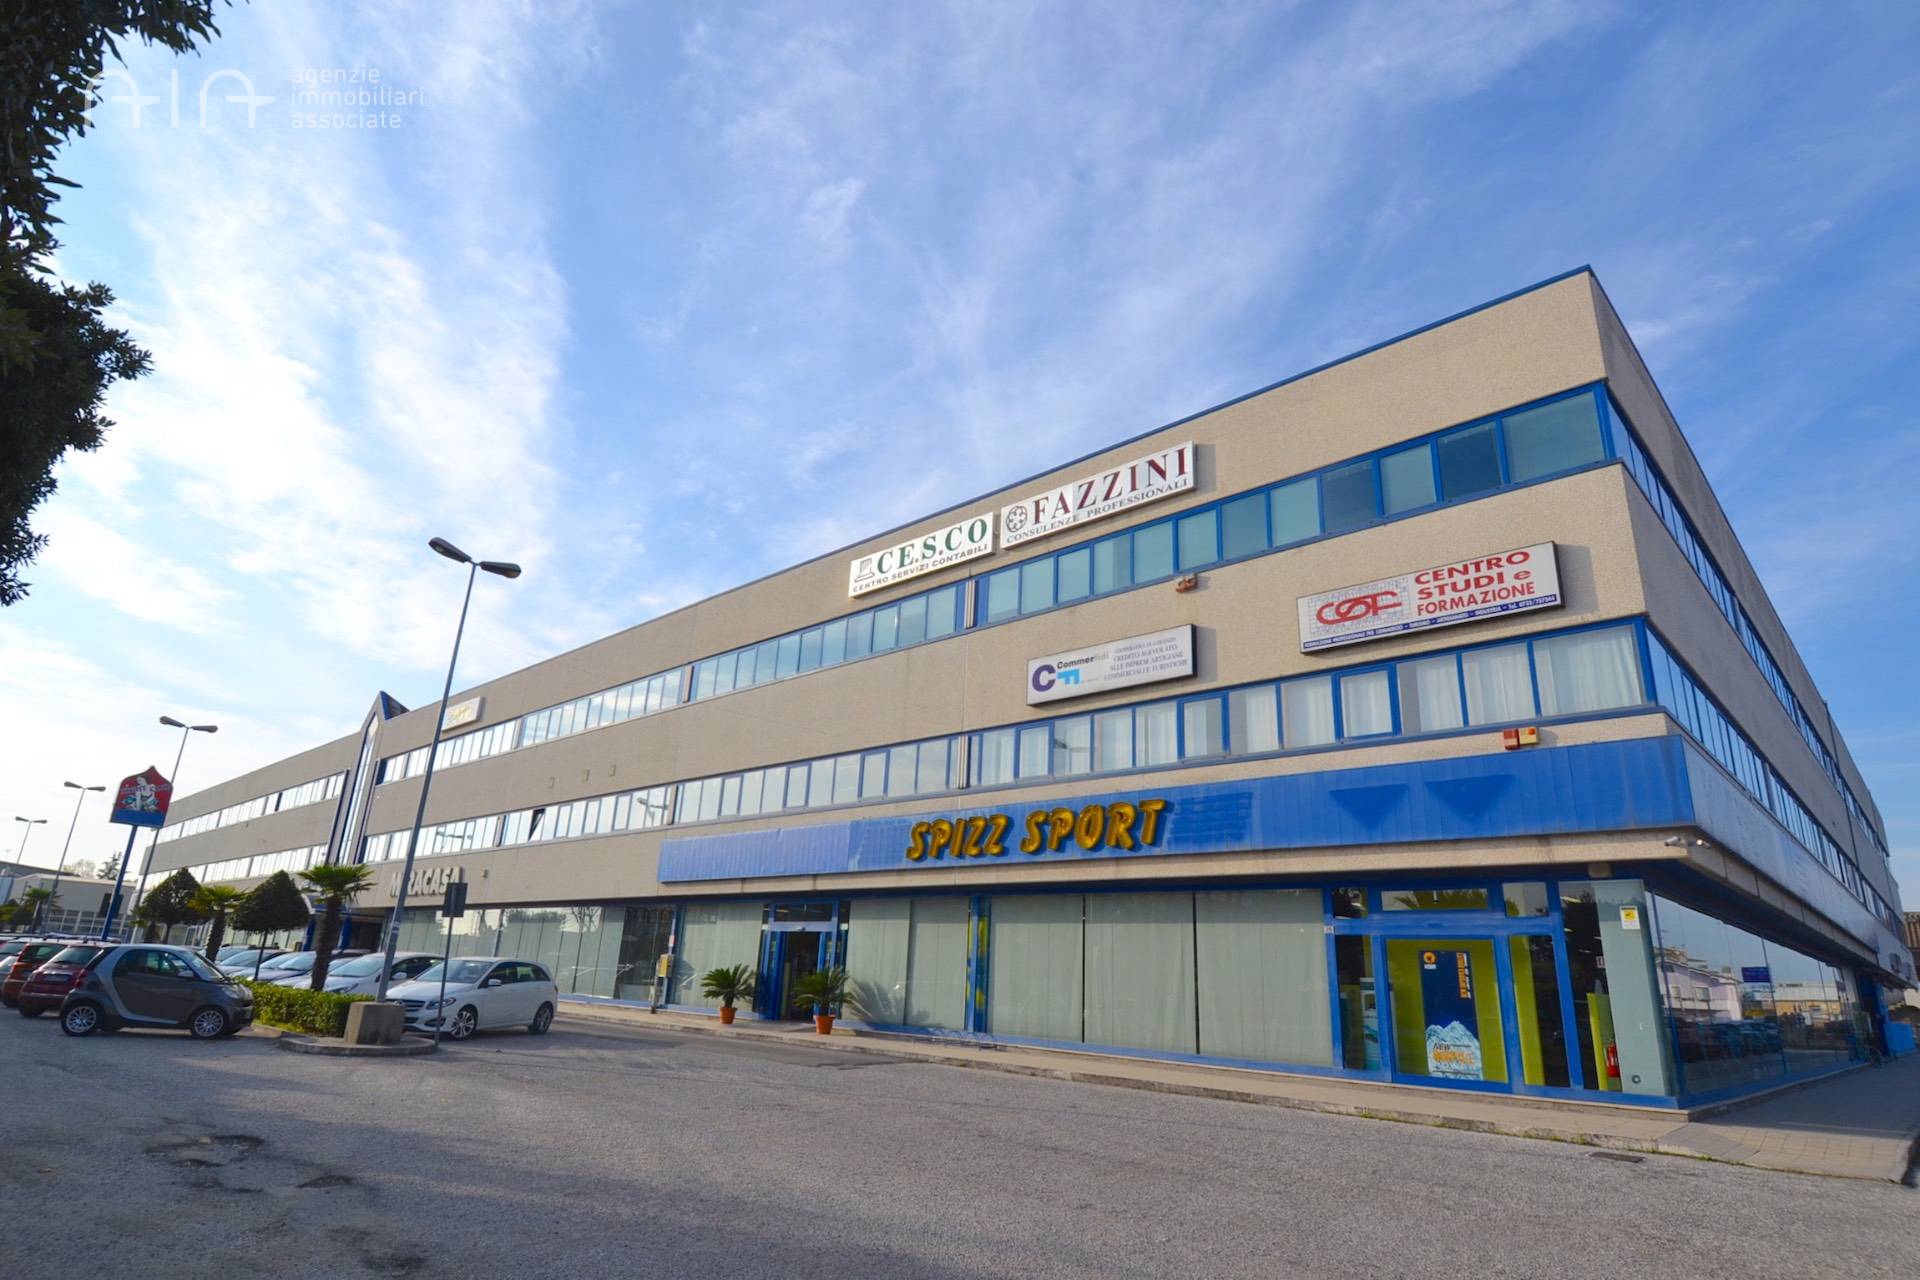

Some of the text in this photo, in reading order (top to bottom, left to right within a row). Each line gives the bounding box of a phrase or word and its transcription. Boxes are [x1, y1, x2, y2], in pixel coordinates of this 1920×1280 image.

[1007, 478, 1188, 544] CONSULENZE PROFESSIONALI
[1032, 447, 1188, 526] FAZZINI
[853, 544, 988, 593] CENTRO SERVIZI CONTABILI
[1414, 551, 1530, 585] CENTRO
[1417, 570, 1531, 600] STUDI e
[1417, 582, 1535, 617] FORMAZIONE
[906, 799, 1166, 861] SPIZZ SPORT
